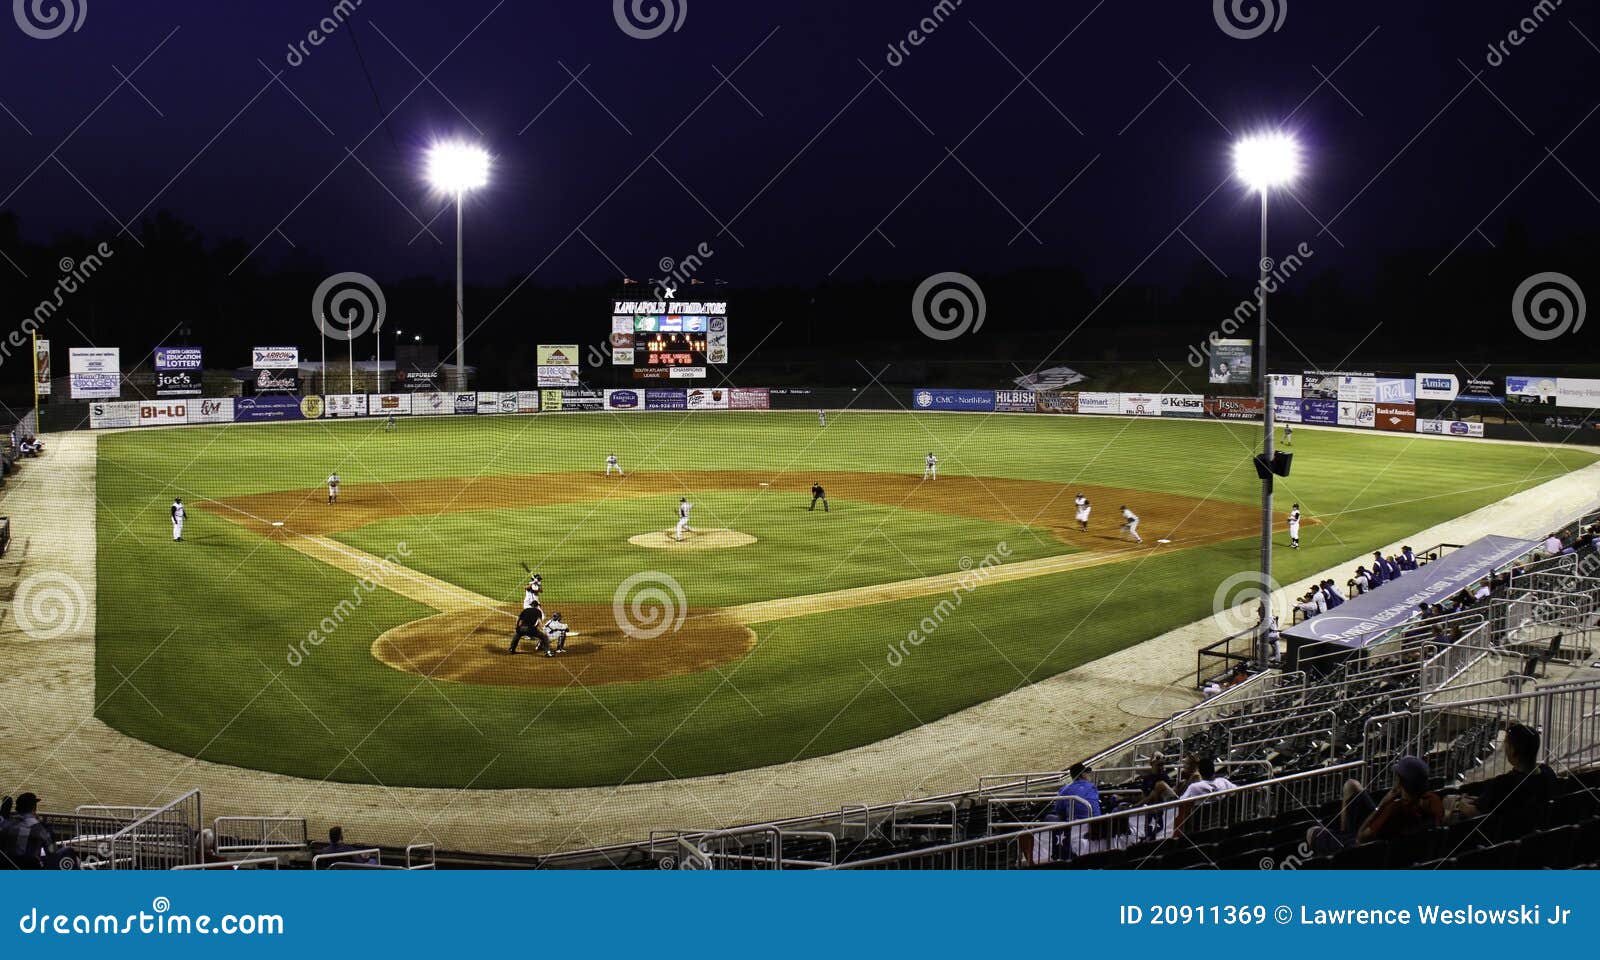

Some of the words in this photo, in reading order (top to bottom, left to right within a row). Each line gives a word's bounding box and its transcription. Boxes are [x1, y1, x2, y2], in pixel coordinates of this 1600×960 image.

[614, 302, 666, 314] KANNAPOLIS
[166, 360, 201, 368] LOTTERY
[1423, 379, 1451, 389] Amica
[456, 394, 475, 402] ASG
[935, 396, 953, 404] CMC
[996, 391, 1036, 403] HILBISH
[1079, 398, 1109, 406] Walmart
[1169, 397, 1204, 408] Kelsan
[140, 405, 186, 418] BI-LO
[1376, 407, 1389, 415] Bank
[1395, 408, 1415, 417] America
